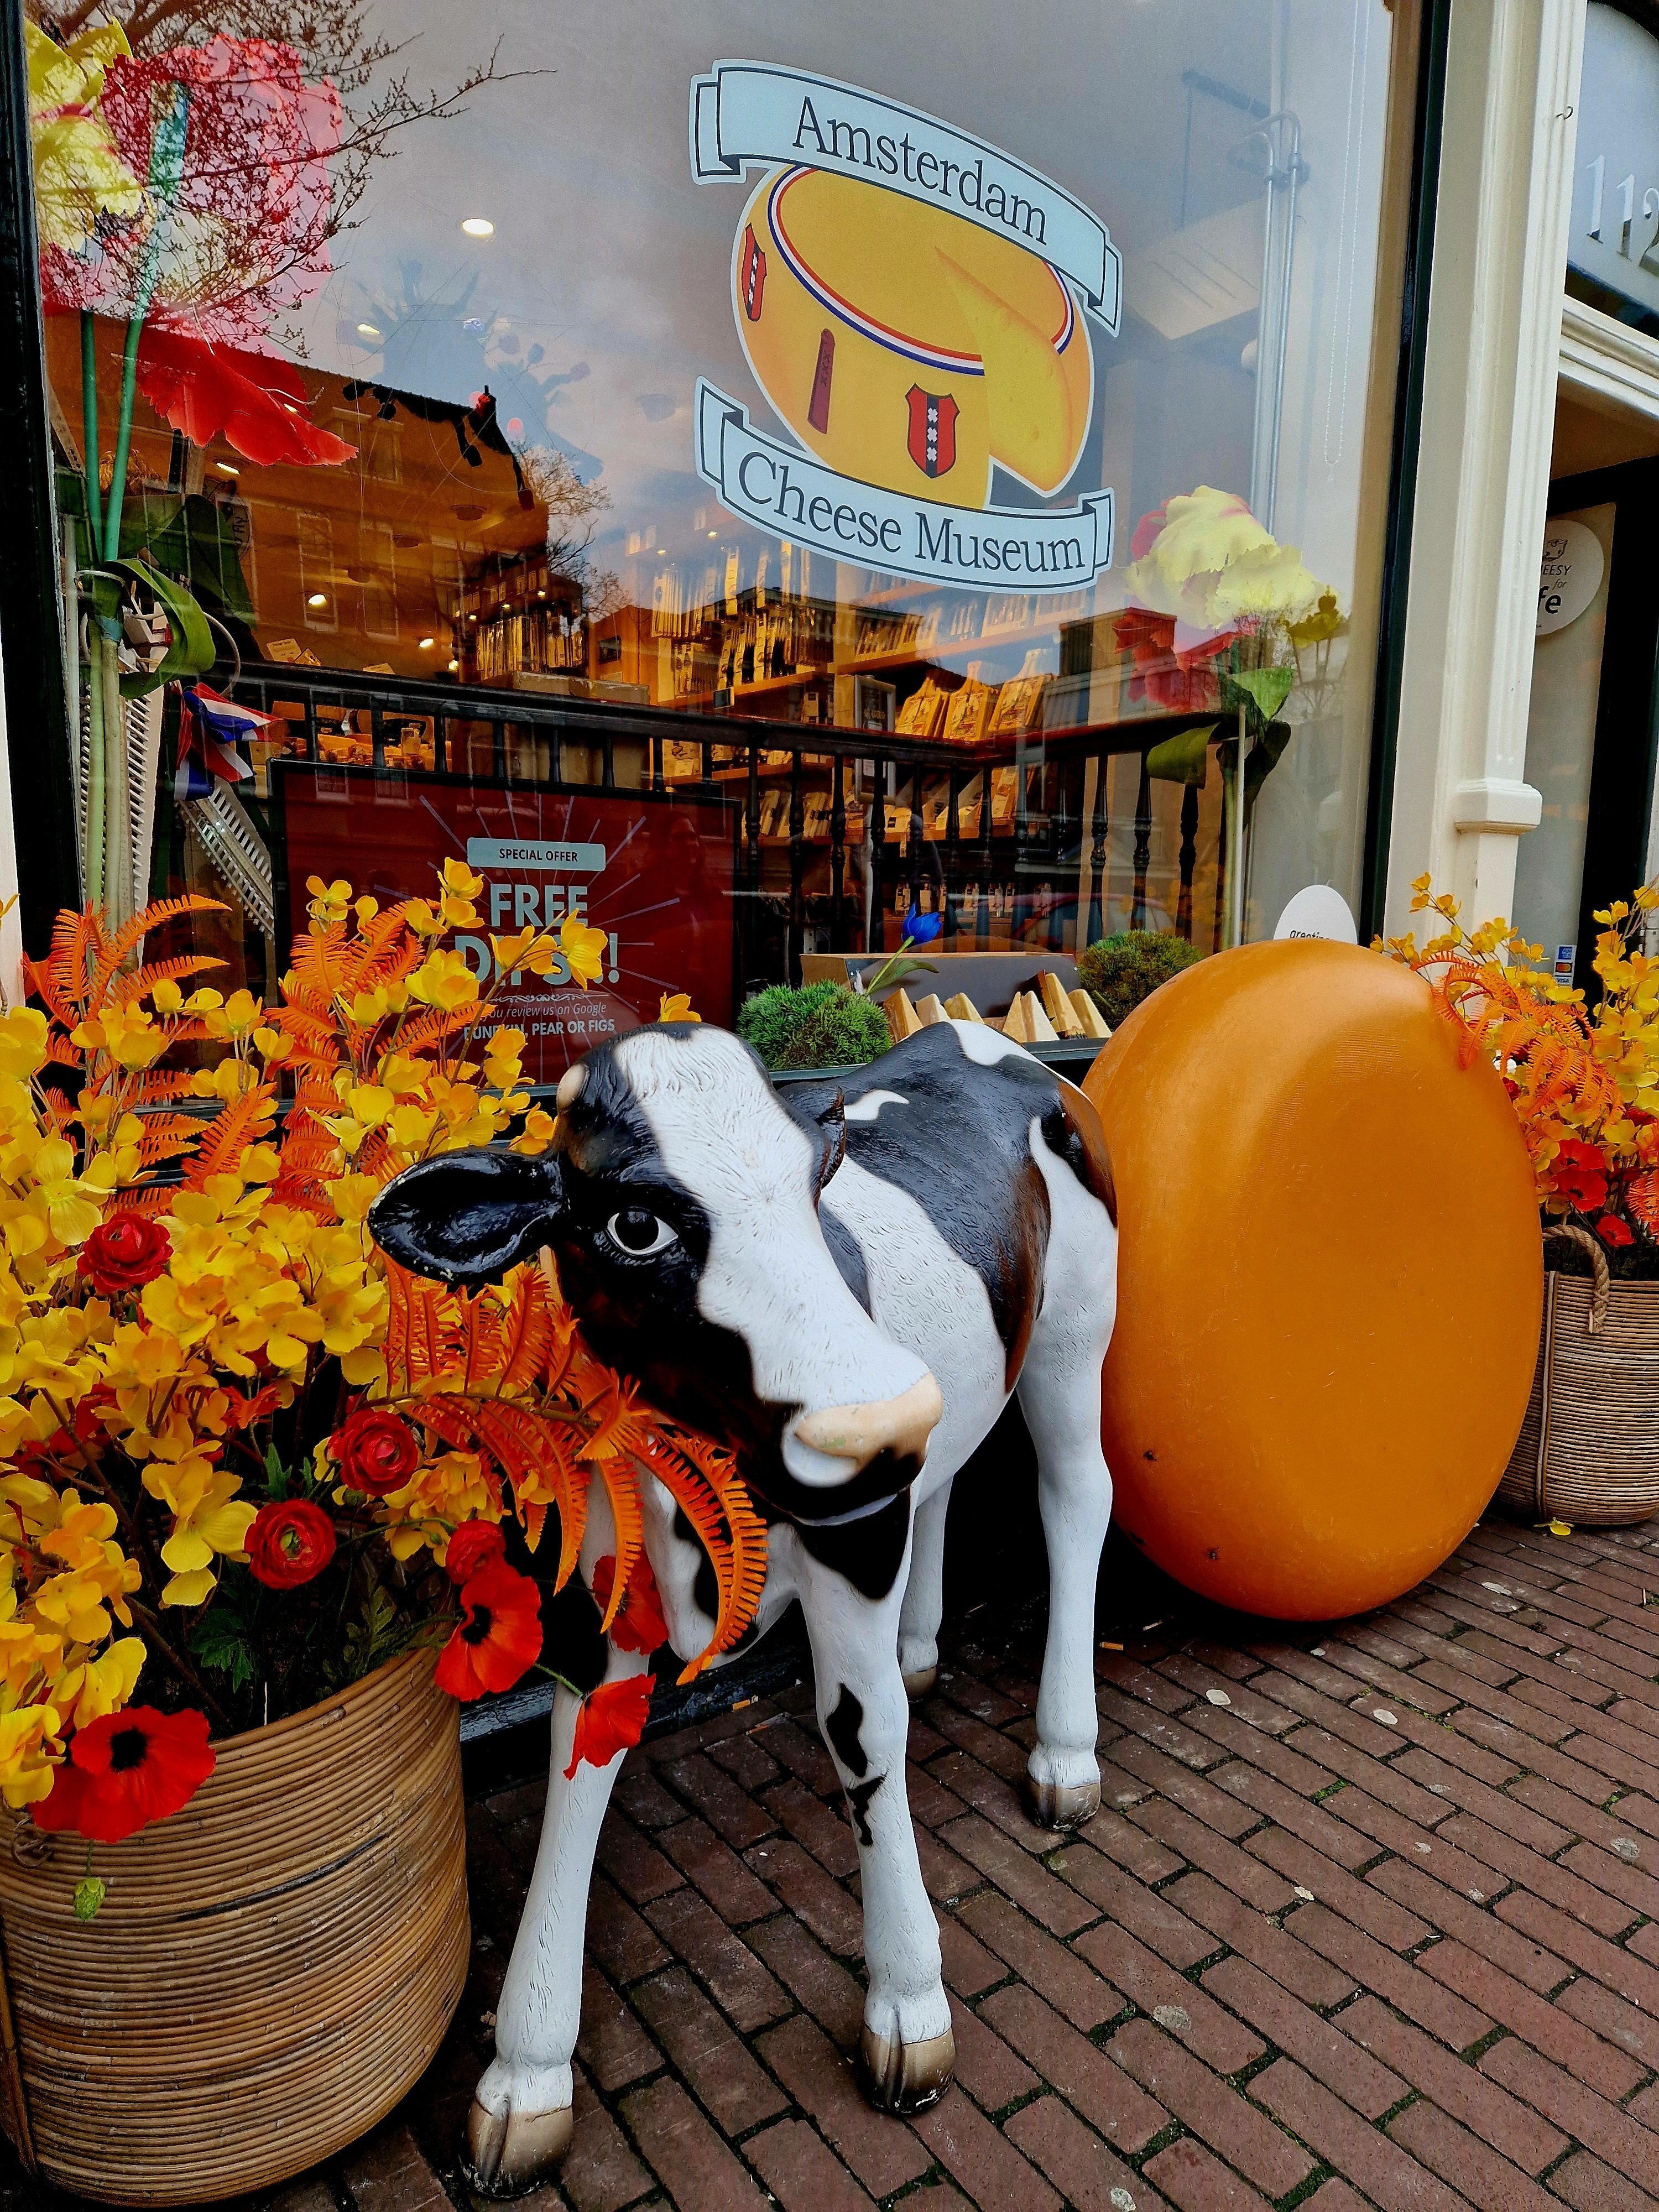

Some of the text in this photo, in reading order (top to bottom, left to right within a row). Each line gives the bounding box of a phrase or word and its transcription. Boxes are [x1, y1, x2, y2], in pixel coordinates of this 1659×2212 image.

[792, 96, 1047, 245] Amsterdam
[1586, 154, 1659, 278] 112
[739, 451, 1086, 572] Cheese Museum
[1541, 564, 1572, 575] EESY
[1552, 578, 1567, 590] for
[499, 848, 578, 862] SPECIAL OFFER
[491, 884, 588, 927] FREE
[455, 933, 620, 985] DS!
[482, 1001, 607, 1022] ou review us on Google
[532, 1021, 565, 1036] PEAR
[567, 1020, 586, 1034] OR
[588, 1019, 615, 1032] FIGS
